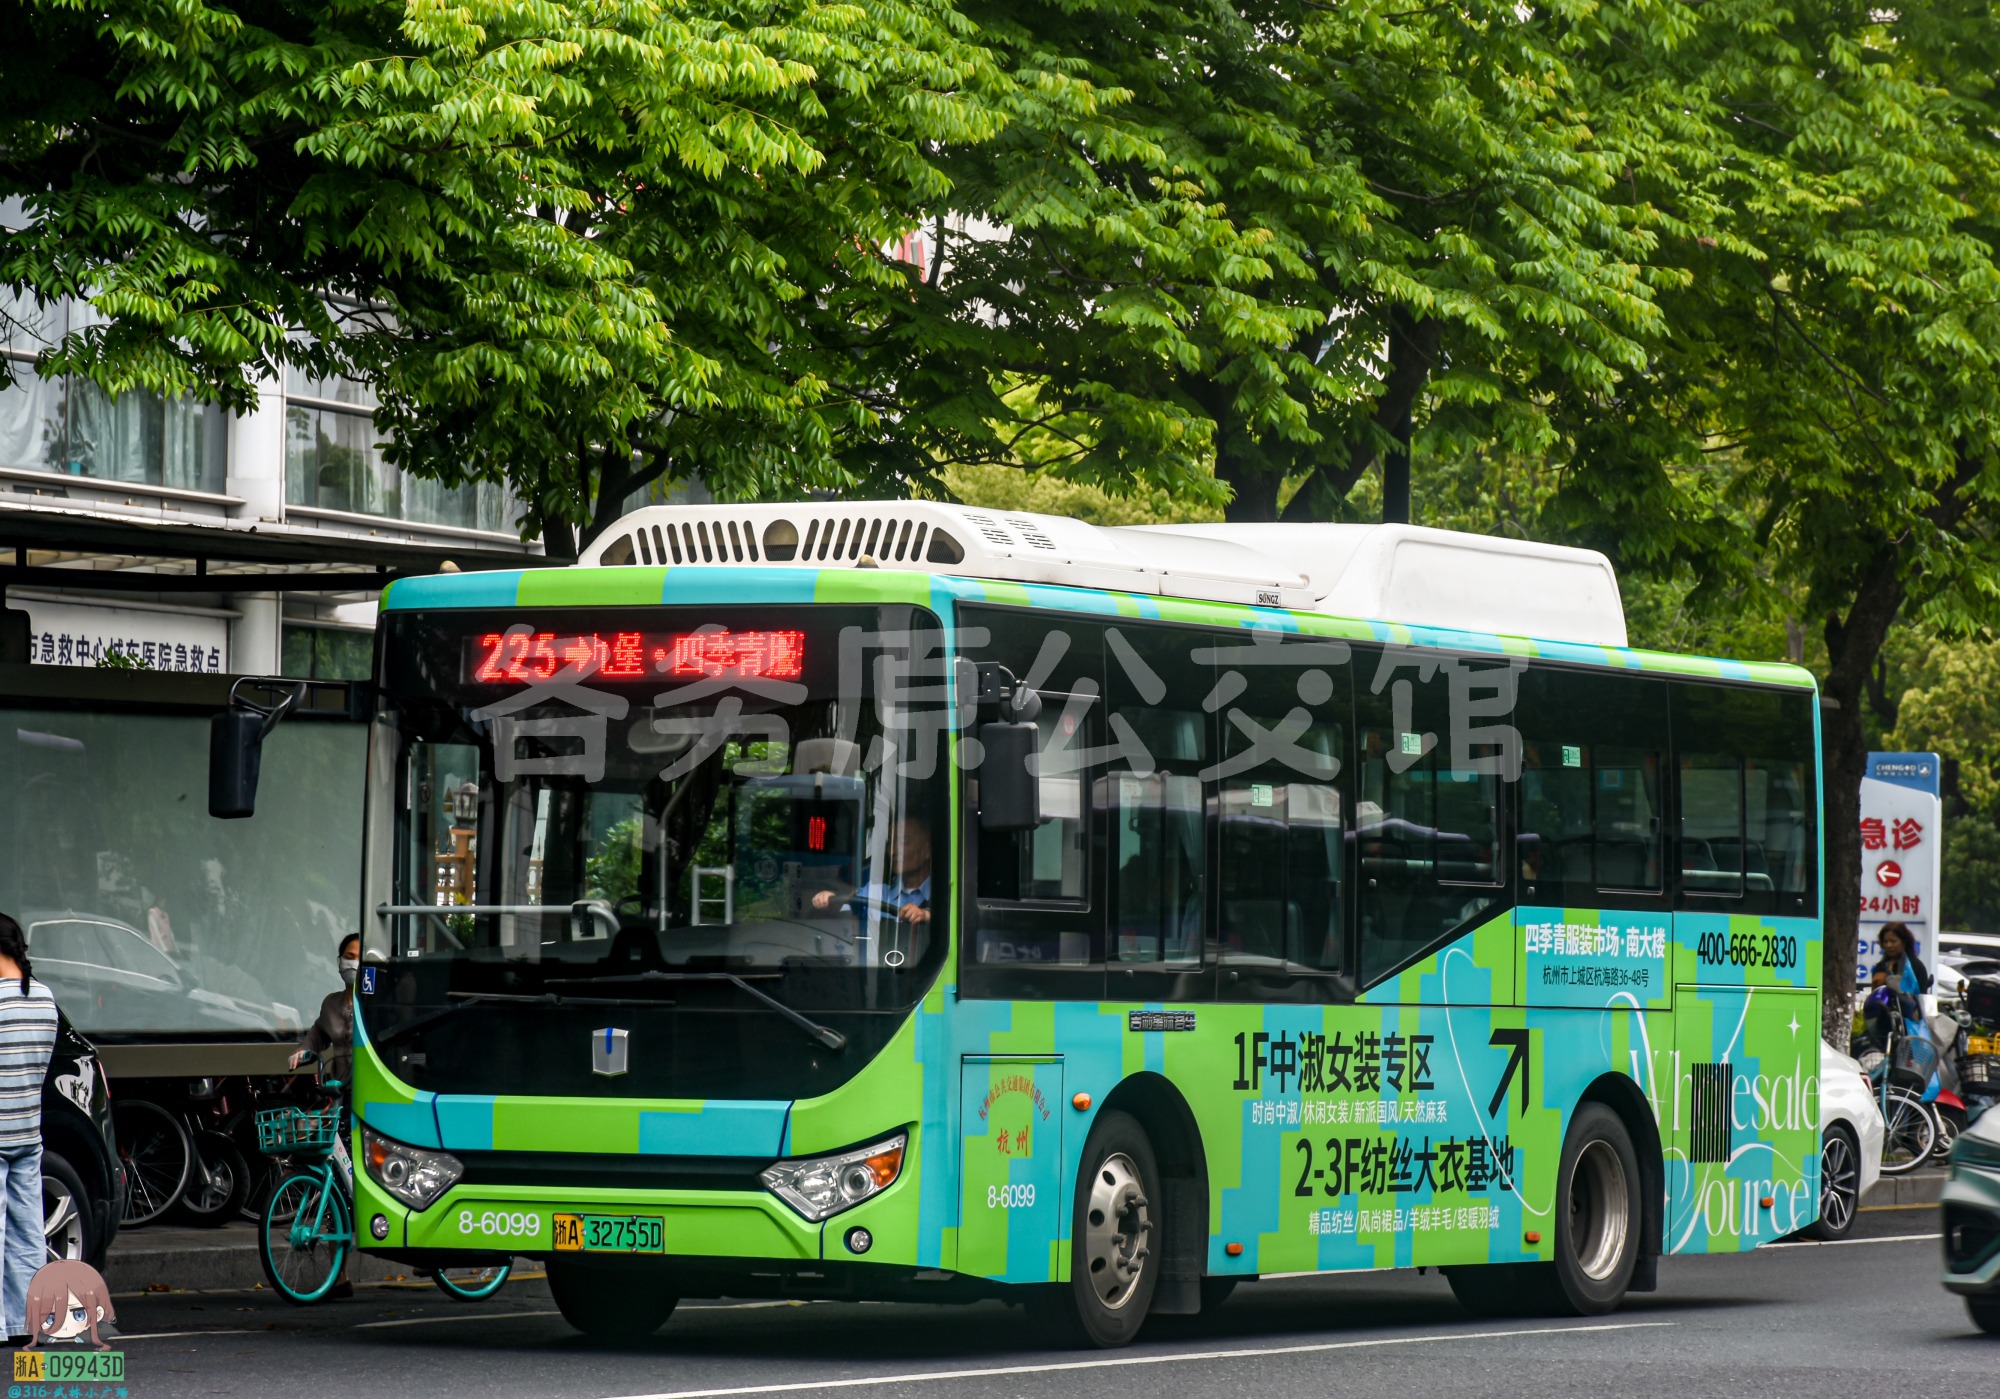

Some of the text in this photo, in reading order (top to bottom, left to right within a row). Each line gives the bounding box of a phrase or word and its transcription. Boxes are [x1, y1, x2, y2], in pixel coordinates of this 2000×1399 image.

[1258, 593, 1279, 605] SONGZ
[481, 633, 556, 678] 225
[1860, 817, 1923, 850] 急诊
[1860, 895, 1920, 914] 24小时
[1525, 922, 1666, 959] 四季青服装市场·南大楼
[1697, 932, 1797, 968] 400-666-2830
[1543, 964, 1649, 988] 杭州市上城区杭海路36-48号
[1233, 1030, 1435, 1093] 1F中淑女装专区
[996, 1124, 1029, 1157] 杭州
[1295, 1135, 1515, 1197] 2-3F纺丝大衣基地
[987, 1184, 1035, 1208] 8-6099
[459, 1210, 541, 1237] 8-6099
